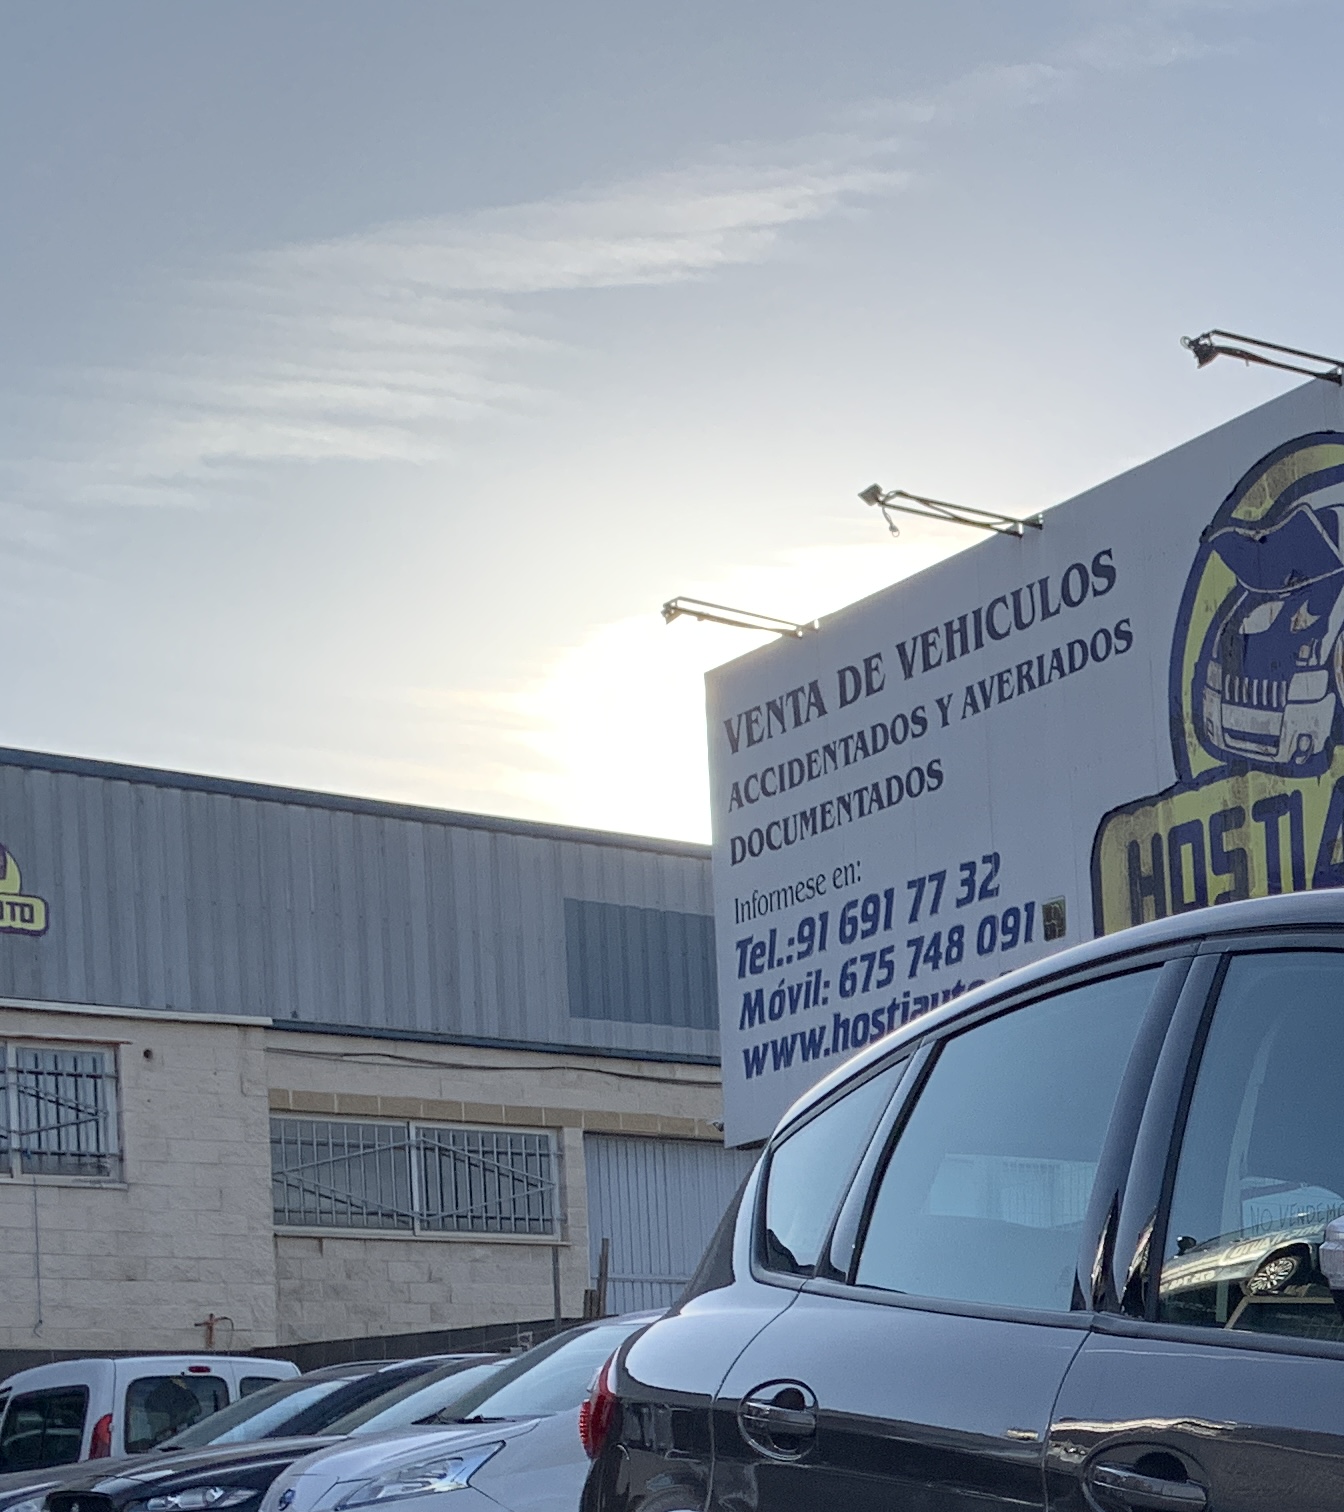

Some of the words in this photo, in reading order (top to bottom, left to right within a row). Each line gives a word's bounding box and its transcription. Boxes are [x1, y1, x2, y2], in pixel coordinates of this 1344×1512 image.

[723, 680, 828, 754] VENTA
[837, 652, 886, 710] DE
[896, 548, 1118, 681] VEHICULOS
[729, 705, 928, 812] ACCIDENTADOS
[935, 694, 956, 731] Y
[961, 618, 1134, 719] AVERIADOS
[730, 758, 944, 866] DOCUMENTADOS
[734, 873, 827, 924] Informese
[832, 860, 862, 890] en:
[839, 886, 894, 946] 691
[907, 869, 946, 923] 77
[956, 852, 1001, 908] 32
[739, 968, 830, 1032] Móvil:
[839, 946, 895, 999] 675
[907, 928, 964, 980] 748
[976, 901, 1036, 956] 091
[1250, 1205, 1272, 1235] NO
